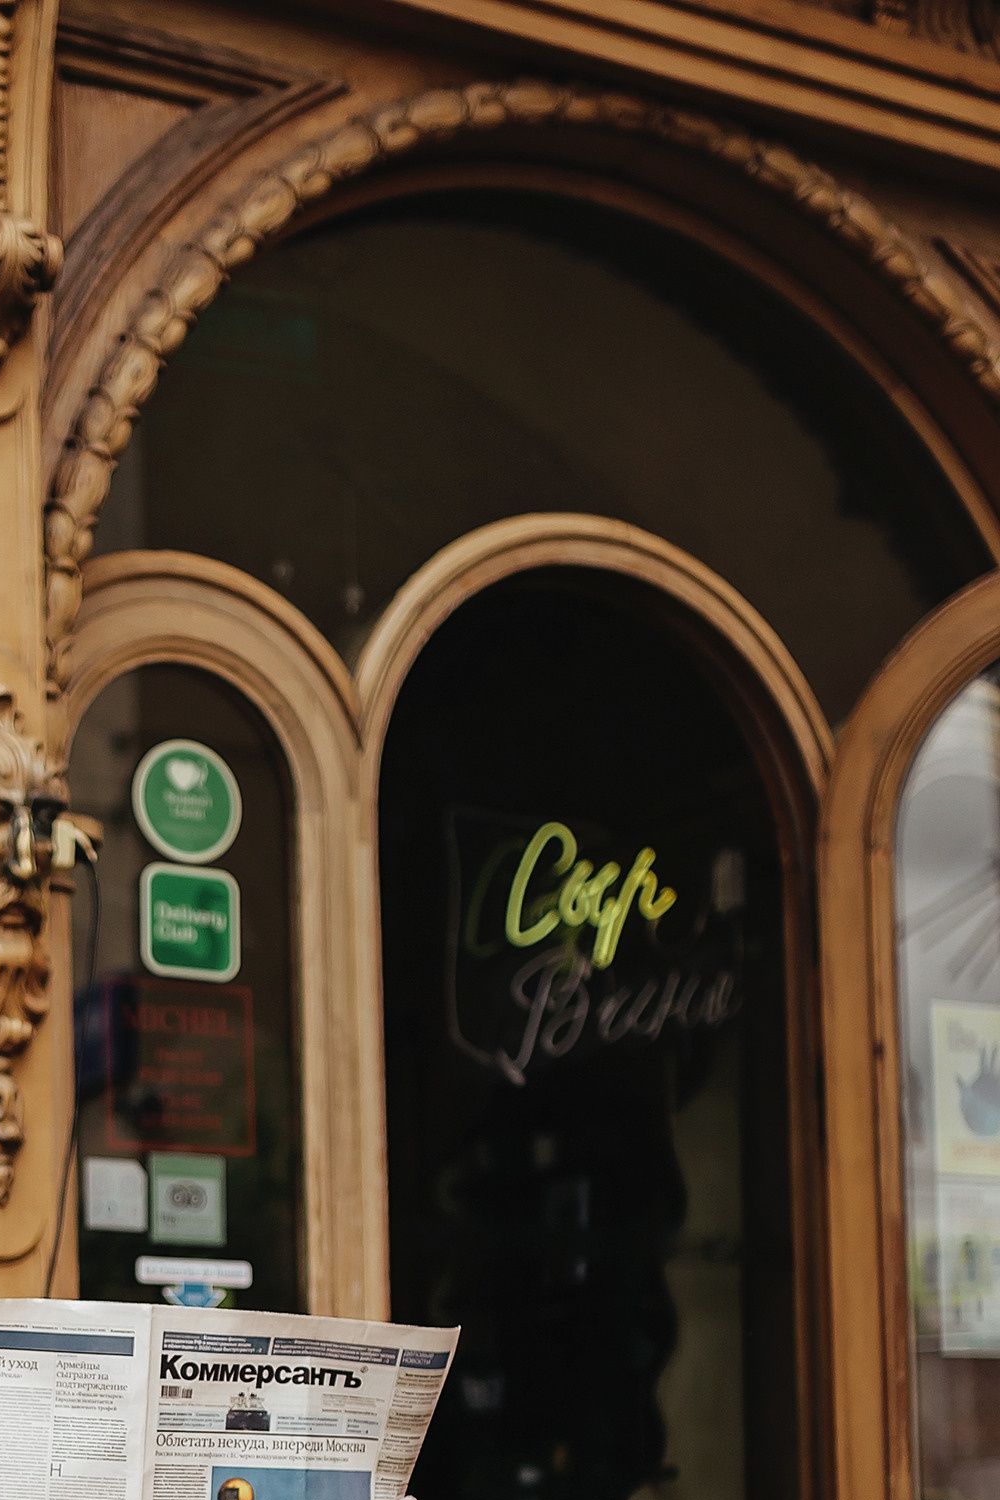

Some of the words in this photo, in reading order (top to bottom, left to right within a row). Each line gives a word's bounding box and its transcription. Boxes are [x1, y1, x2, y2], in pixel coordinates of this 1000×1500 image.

[153, 901, 227, 932] Delivery
[8, 1359, 38, 1371] уход
[56, 1360, 100, 1370] Армейцы
[56, 1371, 97, 1380] сыграют
[160, 1354, 362, 1389] Коммерсантъ
[56, 1380, 128, 1391] подтверждение
[156, 1433, 215, 1448] Облетать
[218, 1437, 269, 1452] некуда,
[272, 1440, 323, 1454] впереди
[326, 1439, 366, 1453] Москва
